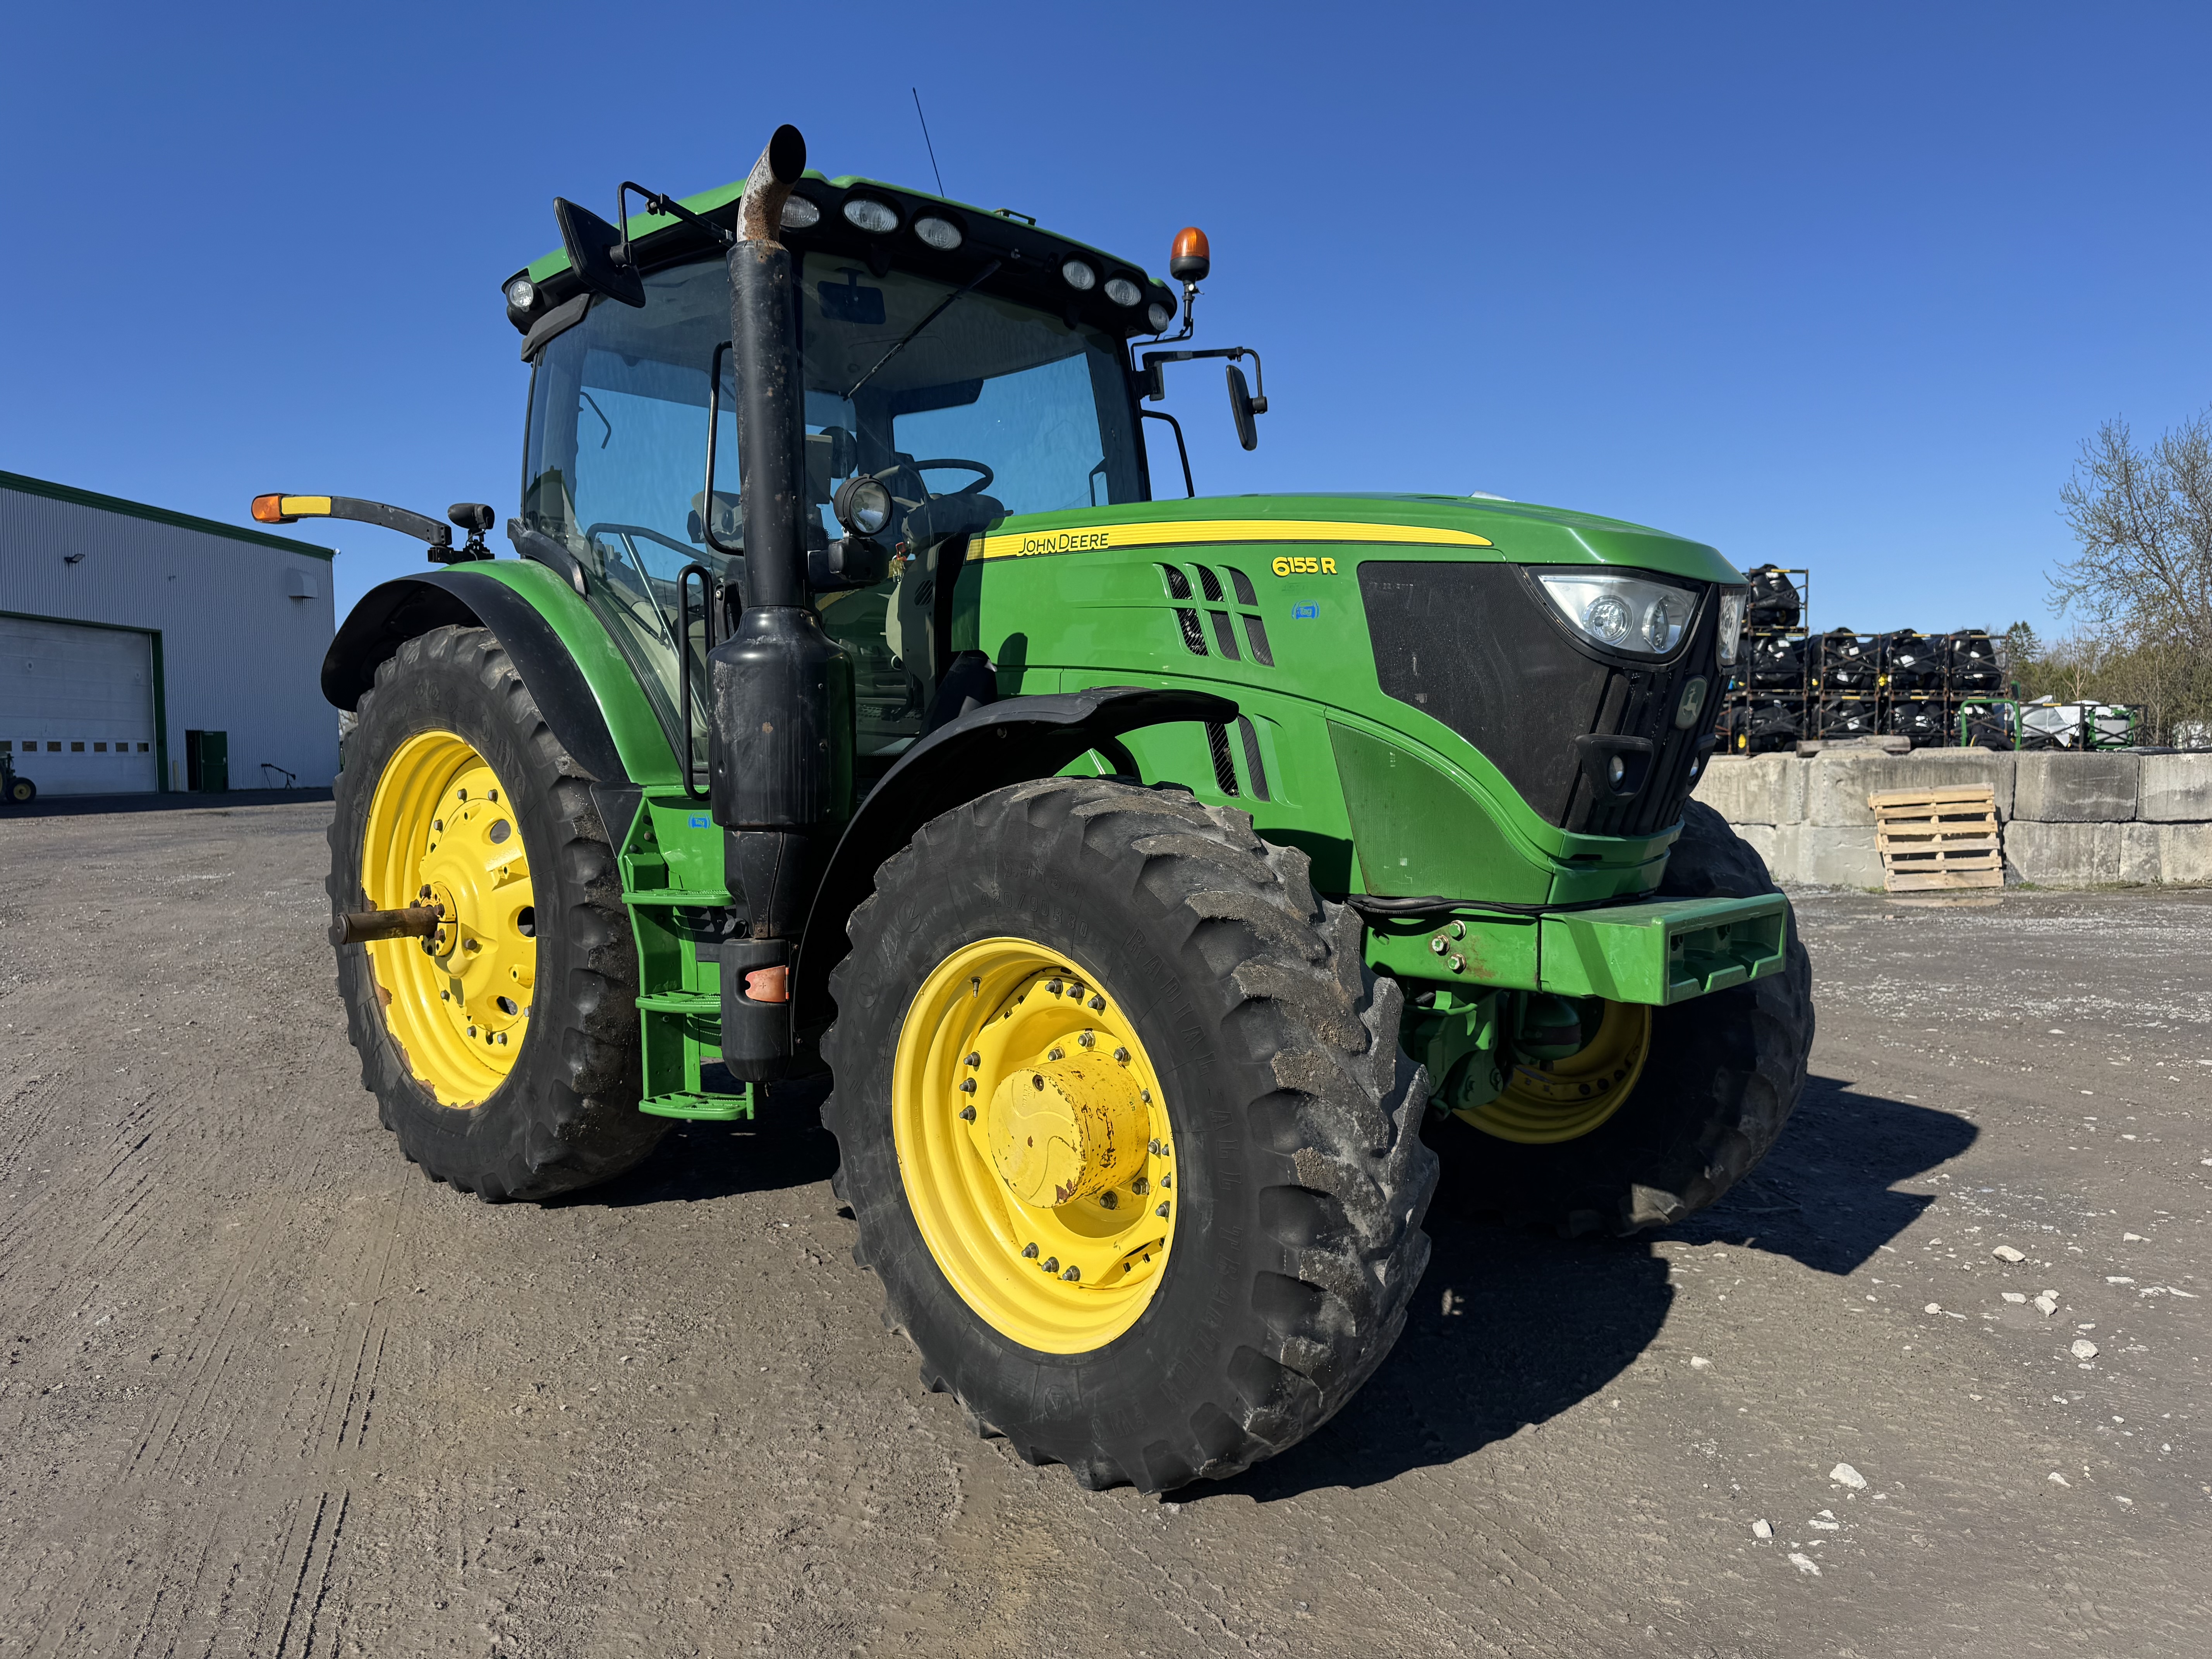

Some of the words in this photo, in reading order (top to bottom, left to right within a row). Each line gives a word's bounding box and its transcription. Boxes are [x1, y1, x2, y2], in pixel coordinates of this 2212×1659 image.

[1017, 537, 1056, 555] JOHN
[1058, 532, 1109, 550] DEERE
[1272, 556, 1319, 577] 6155
[1320, 556, 1338, 575] R
[1125, 928, 1218, 1077] RADIAL
[1210, 1109, 1242, 1190] ALL
